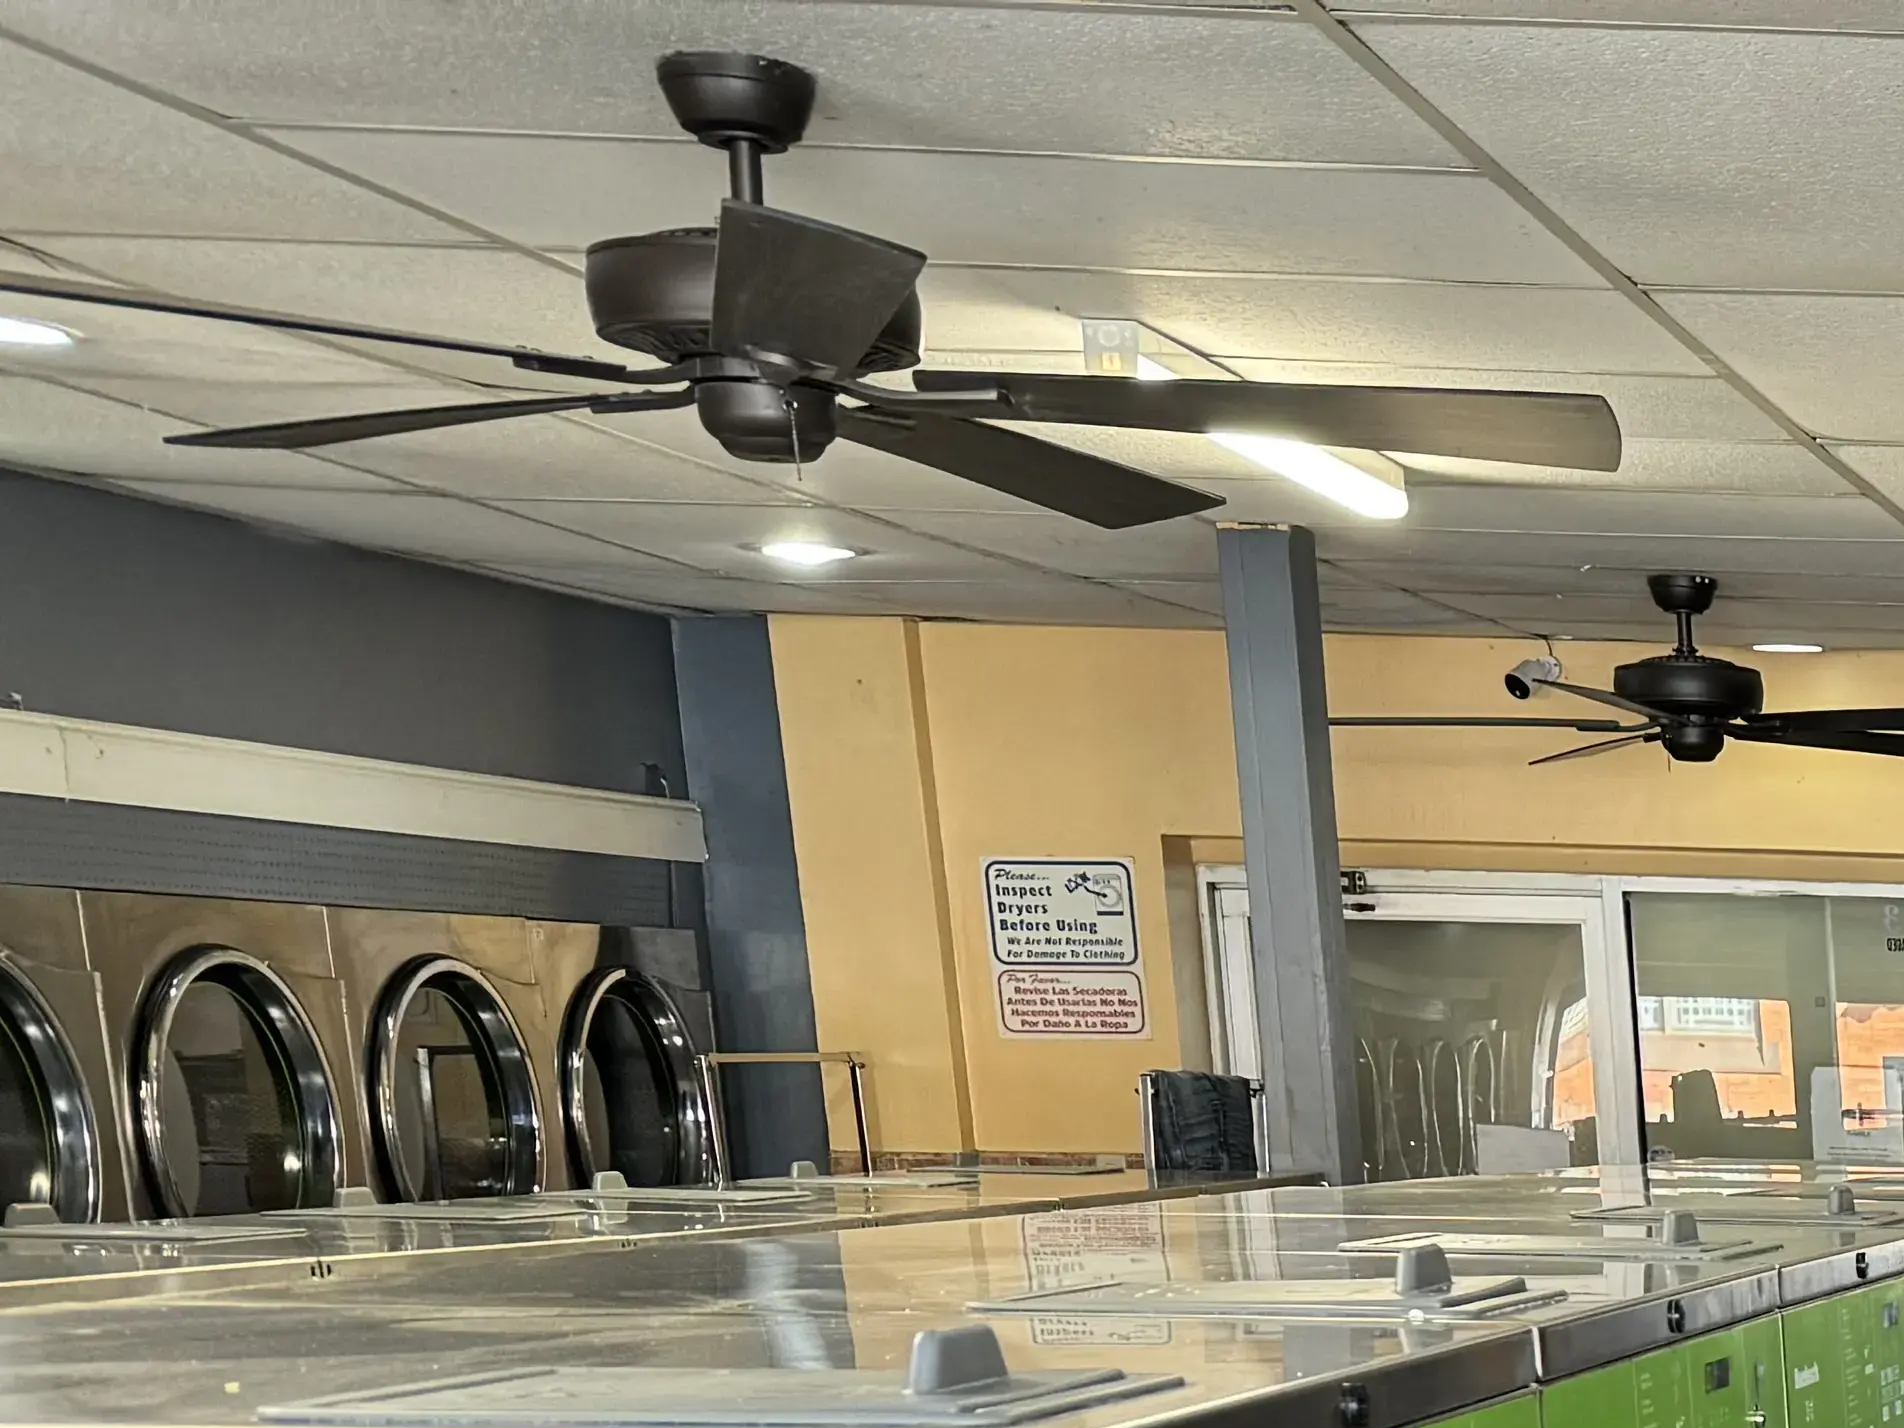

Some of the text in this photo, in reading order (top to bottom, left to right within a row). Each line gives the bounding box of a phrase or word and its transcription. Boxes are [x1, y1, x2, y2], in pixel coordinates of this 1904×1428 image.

[995, 884, 1053, 899] Inspect
[997, 902, 1048, 916] Dryers
[999, 919, 1098, 934] Before Using
[1007, 937, 1123, 948] We Are Not Responsible
[1007, 950, 1125, 960] For Damage To Clothing
[1014, 986, 1127, 997] Revise Las Secadoras
[1007, 998, 1037, 1007] Antes
[1040, 998, 1055, 1007] De
[1100, 998, 1115, 1007] No
[1117, 999, 1138, 1008] Nos
[1011, 1009, 1136, 1019] Hacemos Responsables
[1021, 1020, 1039, 1028] Por
[1100, 1020, 1129, 1030] Ropa
